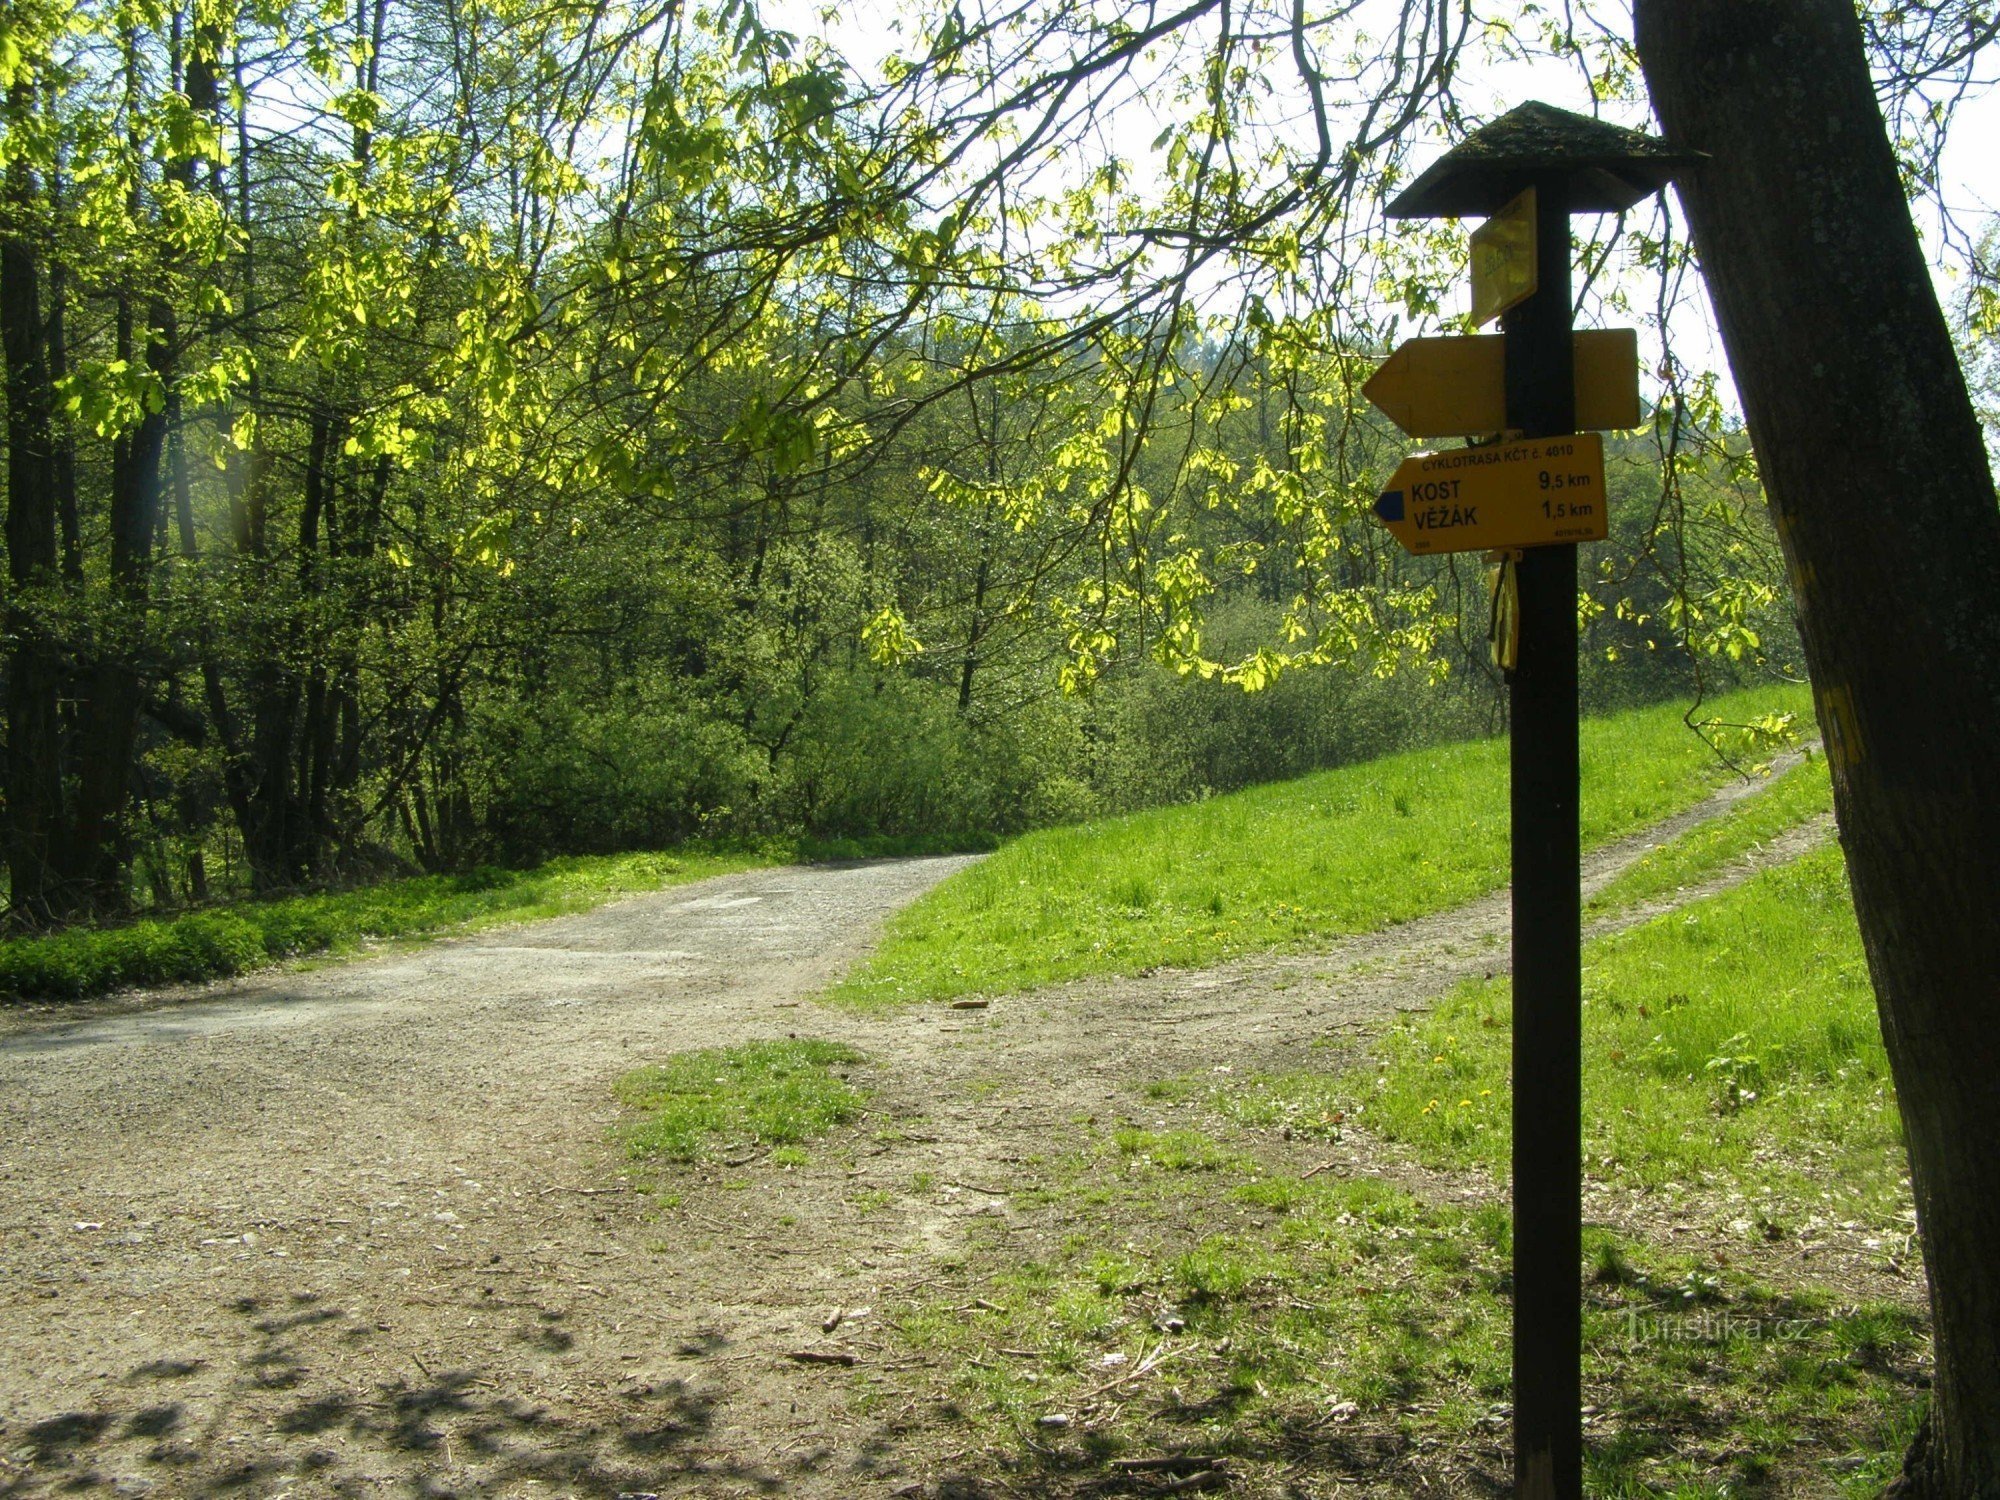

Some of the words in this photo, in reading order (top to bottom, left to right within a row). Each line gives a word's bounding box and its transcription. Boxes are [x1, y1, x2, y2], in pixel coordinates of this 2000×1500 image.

[1422, 453, 1500, 471] CYKLOTRASA
[1504, 447, 1527, 461] KČT
[1412, 480, 1460, 502] KOST
[1539, 470, 1563, 490] 9,5
[1568, 472, 1590, 486] km
[1414, 504, 1477, 530] VĚŽÁK
[1542, 500, 1565, 520] 1,5
[1570, 502, 1592, 517] km
